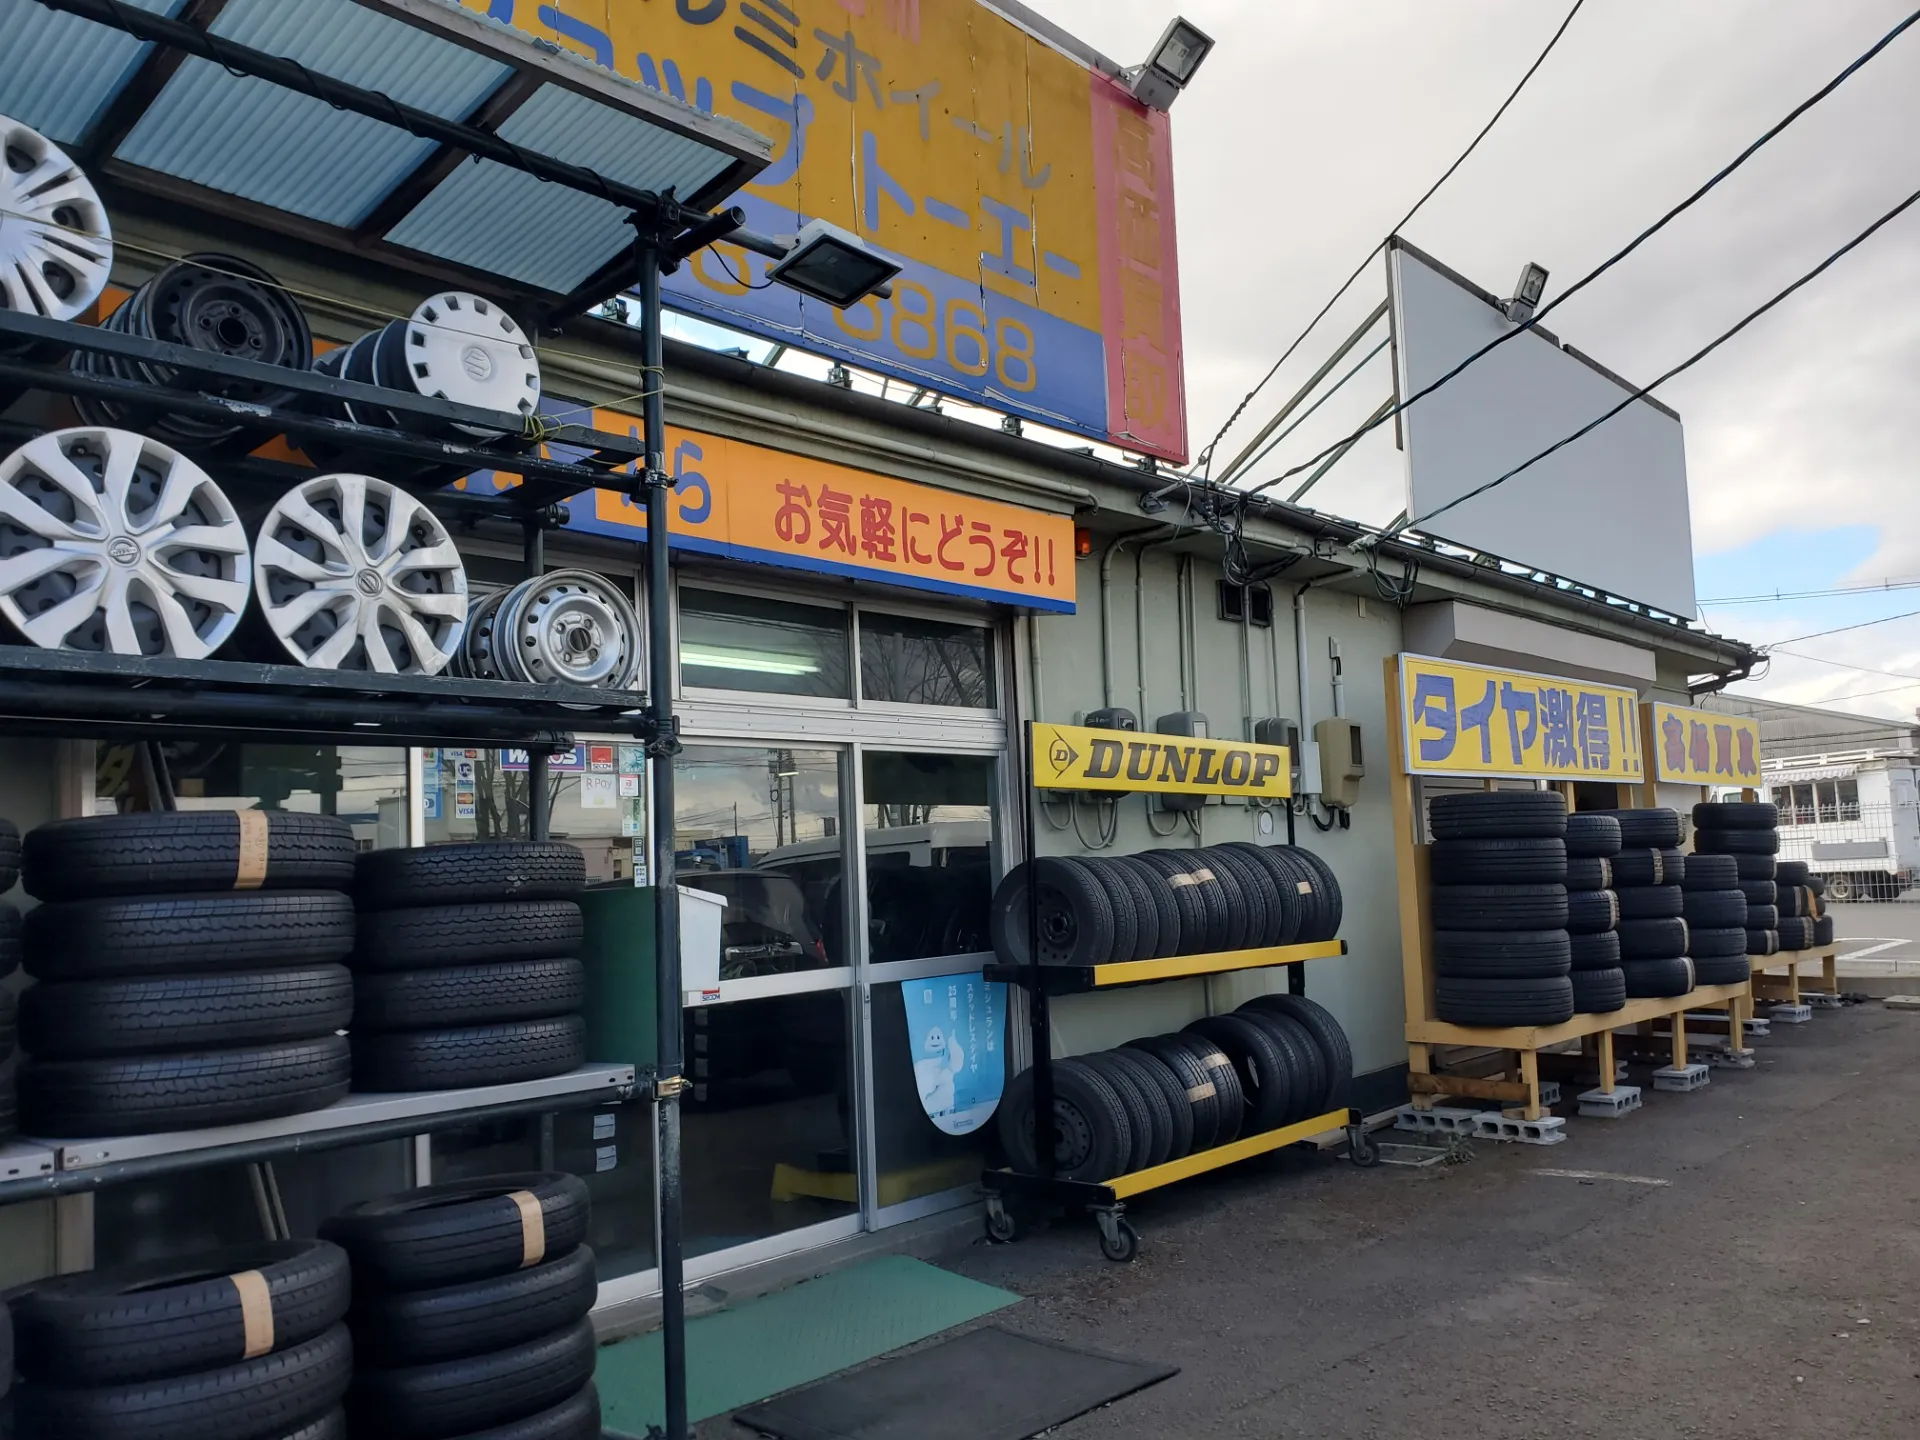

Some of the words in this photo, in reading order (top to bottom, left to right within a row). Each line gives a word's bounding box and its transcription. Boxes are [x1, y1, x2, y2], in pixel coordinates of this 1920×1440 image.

[1413, 672, 1640, 773] タイヤ激得!!
[1083, 738, 1280, 787] DUNLOP
[459, 807, 474, 815] VISA
